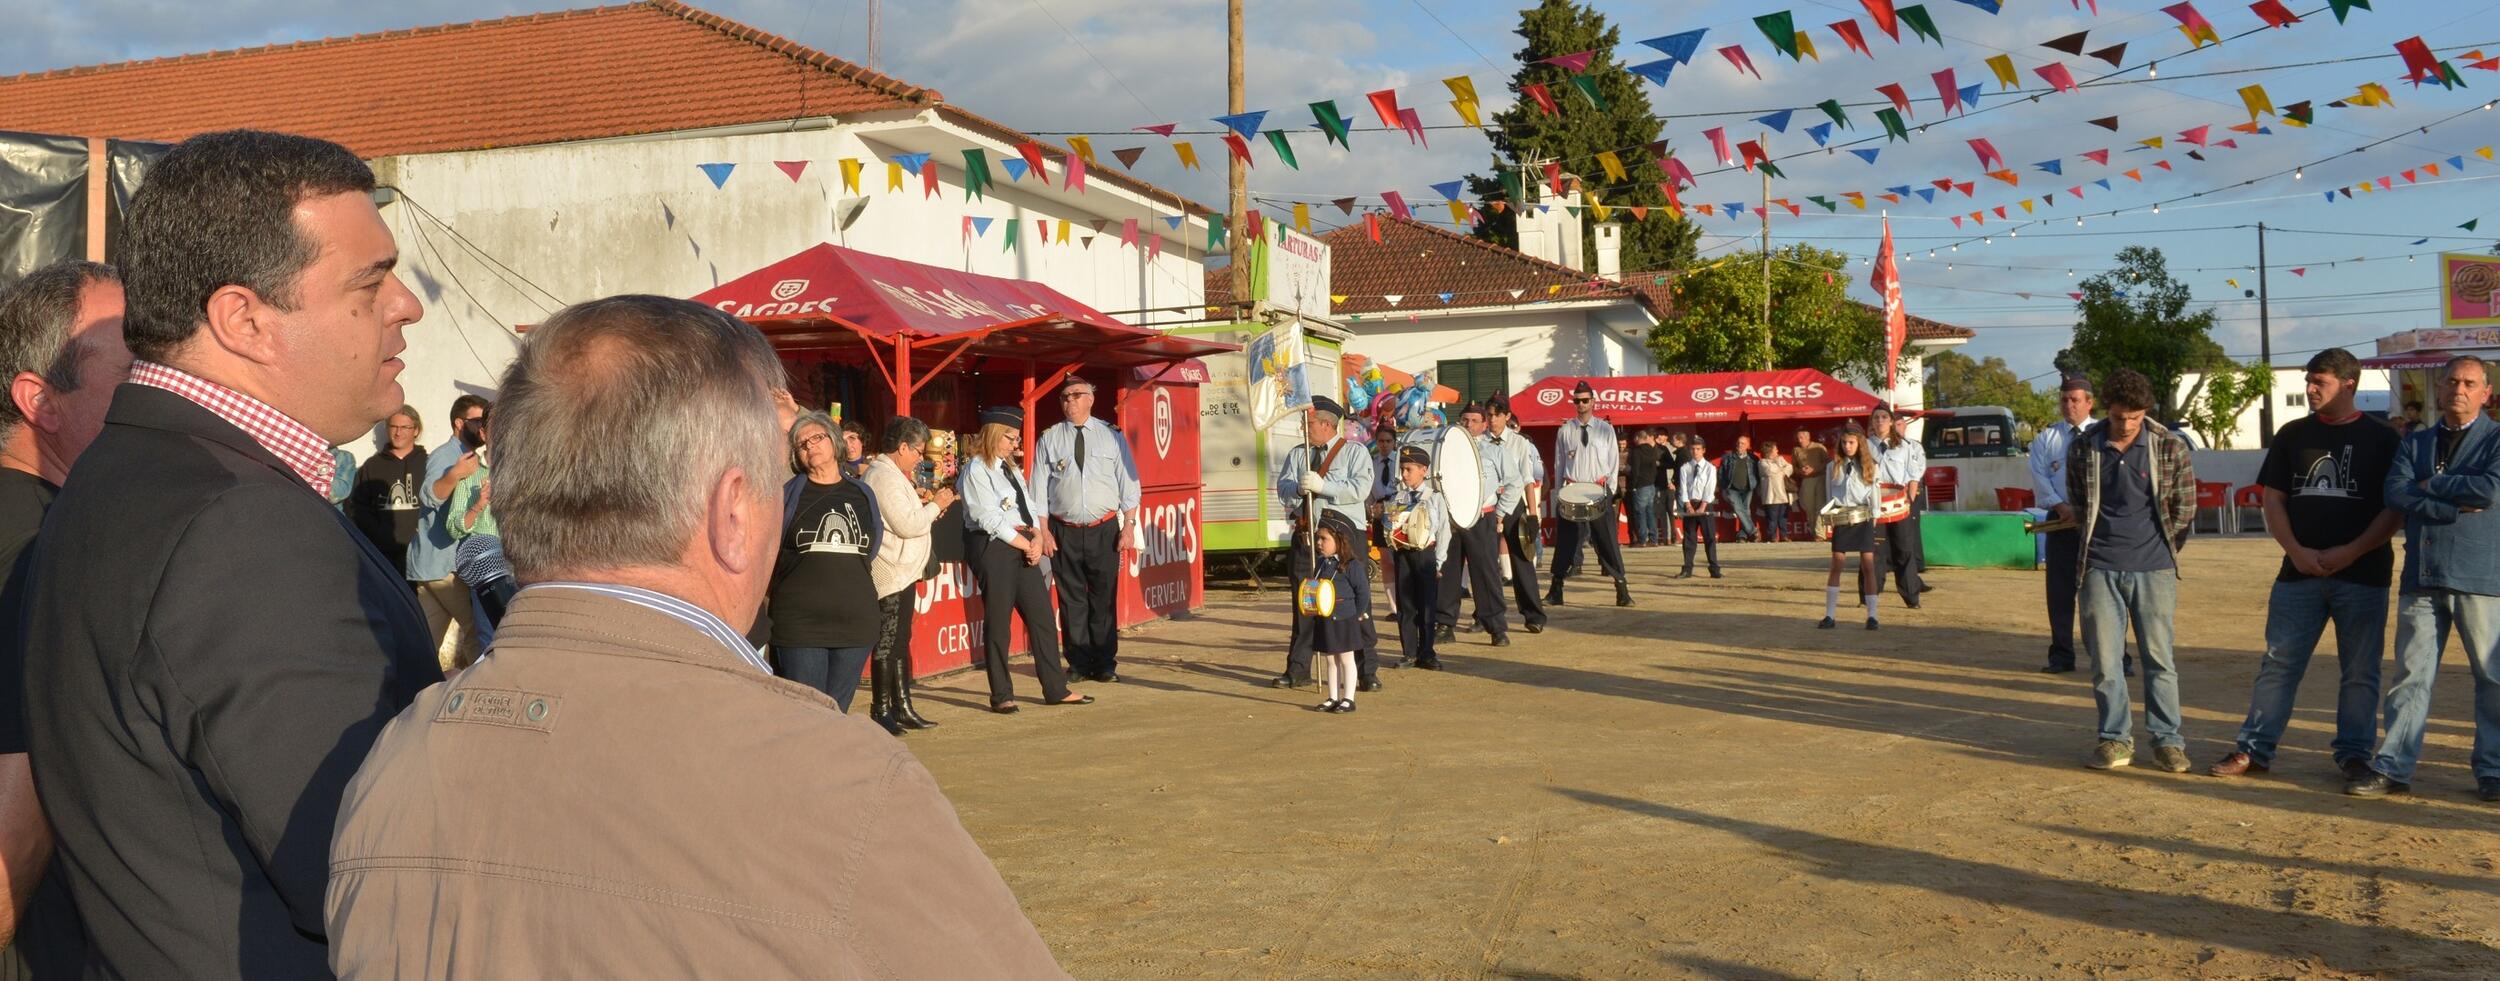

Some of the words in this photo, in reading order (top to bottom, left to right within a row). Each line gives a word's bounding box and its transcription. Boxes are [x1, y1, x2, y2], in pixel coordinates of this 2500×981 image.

[1724, 383, 1824, 400] SAGRES
[1594, 403, 1643, 411] ERVEJA
[1144, 580, 1186, 610] CERVEJA
